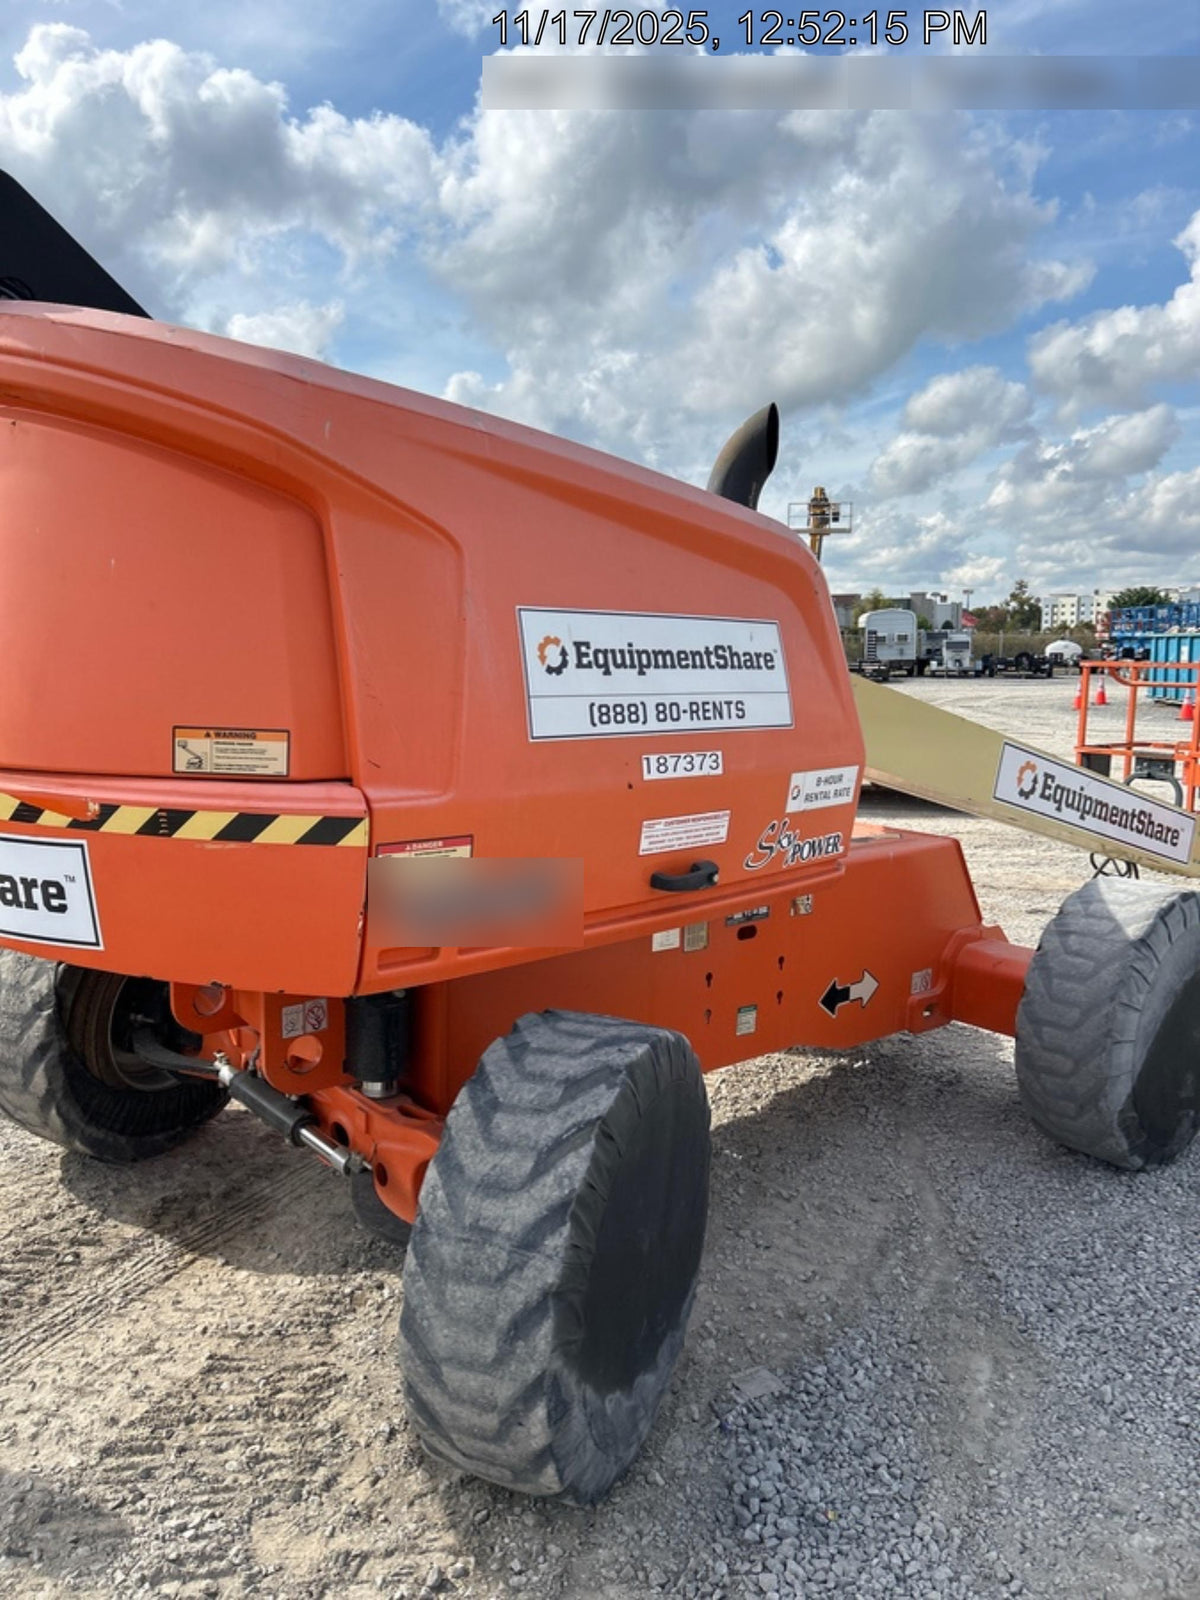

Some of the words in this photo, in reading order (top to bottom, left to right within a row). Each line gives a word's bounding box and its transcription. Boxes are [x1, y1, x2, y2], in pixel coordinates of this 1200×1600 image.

[573, 641, 776, 676] EquipmentShare
[589, 701, 648, 727] (888)
[655, 700, 746, 723] 80-RENTS
[214, 730, 257, 740] WARNING
[643, 752, 721, 775] 187373
[804, 790, 832, 803] RENTAL
[833, 787, 851, 798] RATE
[1039, 771, 1180, 847] EquipmentShare
